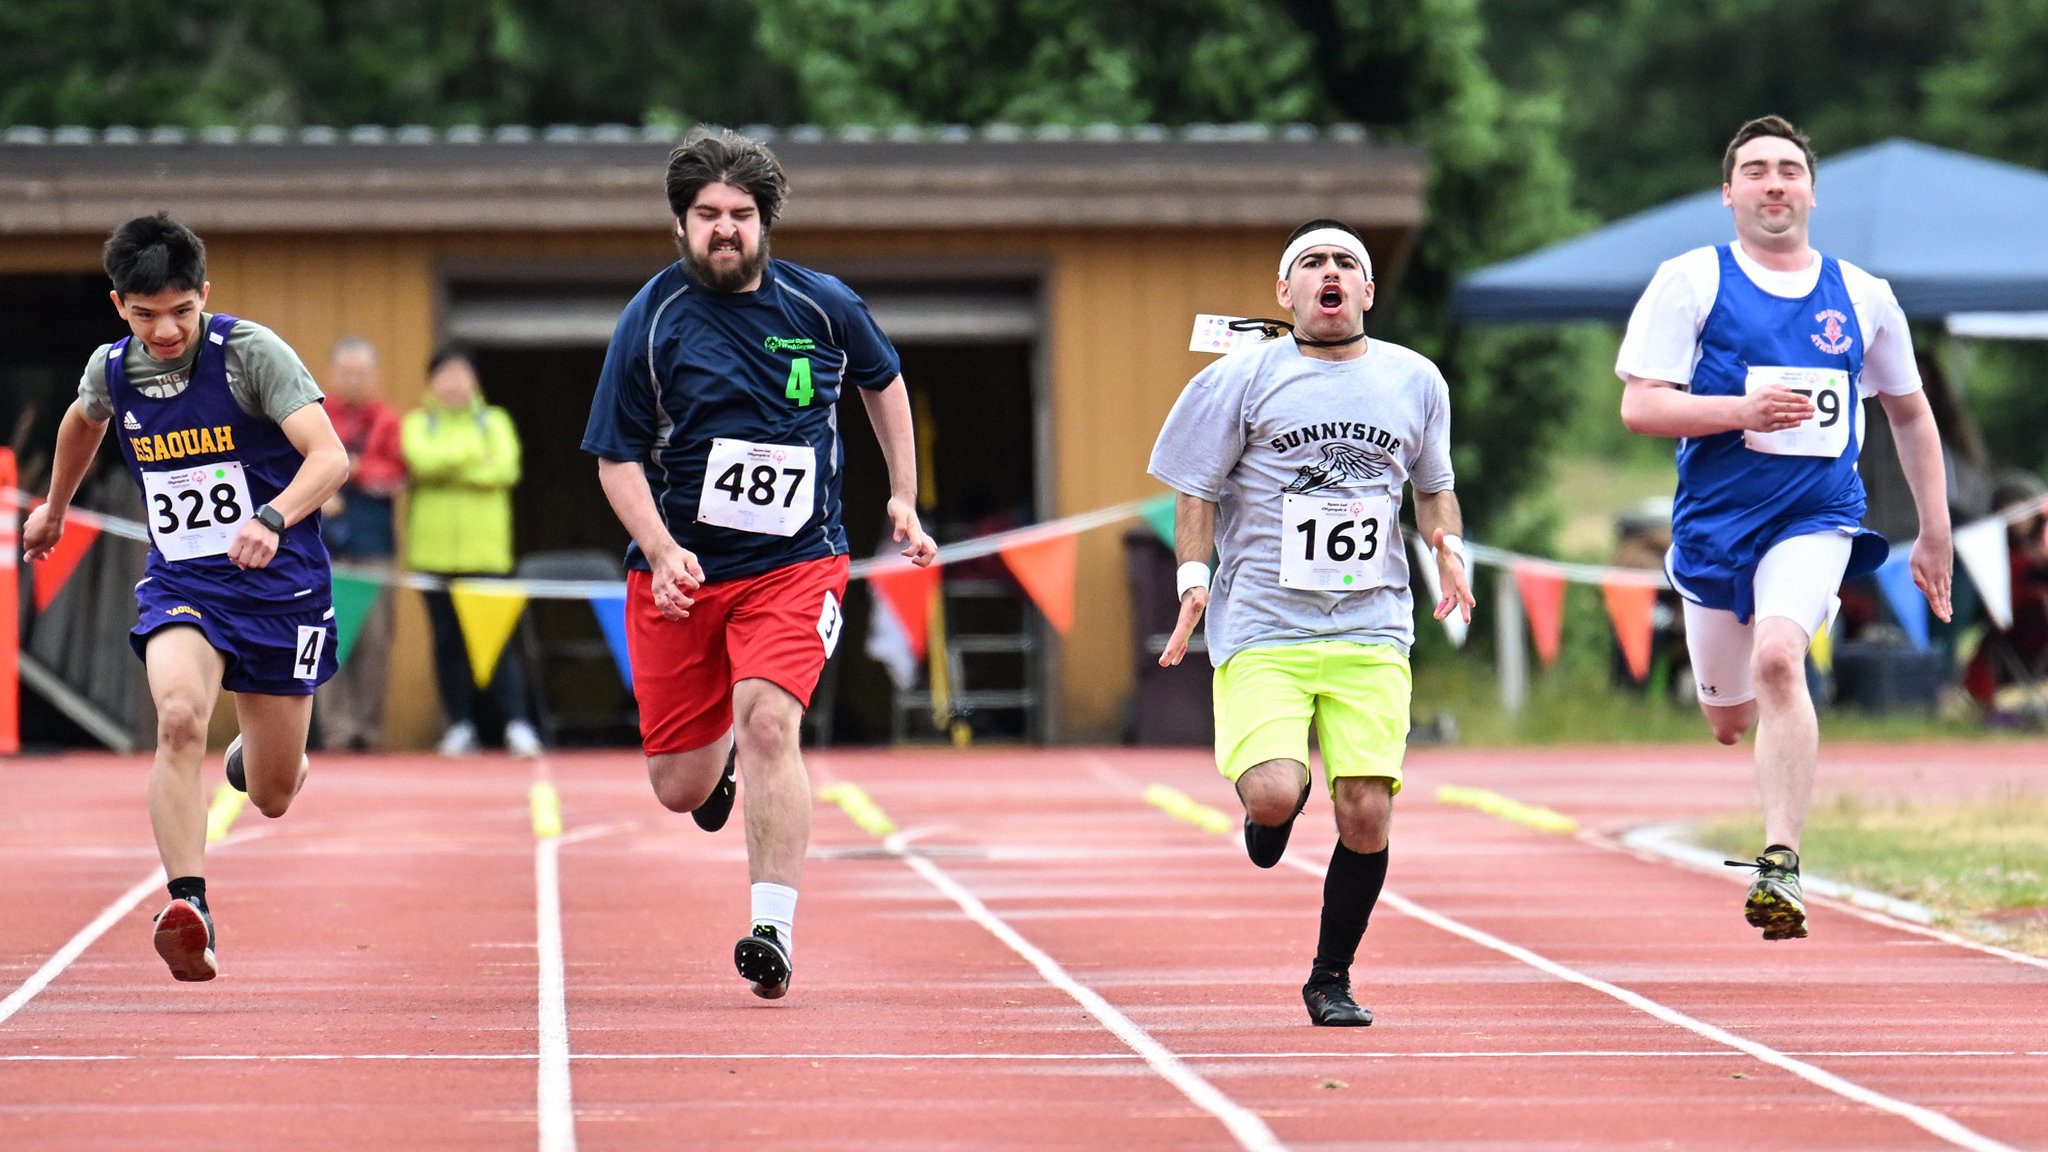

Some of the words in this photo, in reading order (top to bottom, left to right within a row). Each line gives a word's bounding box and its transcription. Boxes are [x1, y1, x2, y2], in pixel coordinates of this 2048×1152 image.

[785, 357, 814, 407] 4
[1271, 422, 1400, 456] SUNNYSIDE
[714, 462, 806, 508] 487
[153, 483, 241, 535] 328
[1296, 518, 1378, 562] 163
[825, 605, 836, 640] 3
[299, 631, 319, 675] 4
